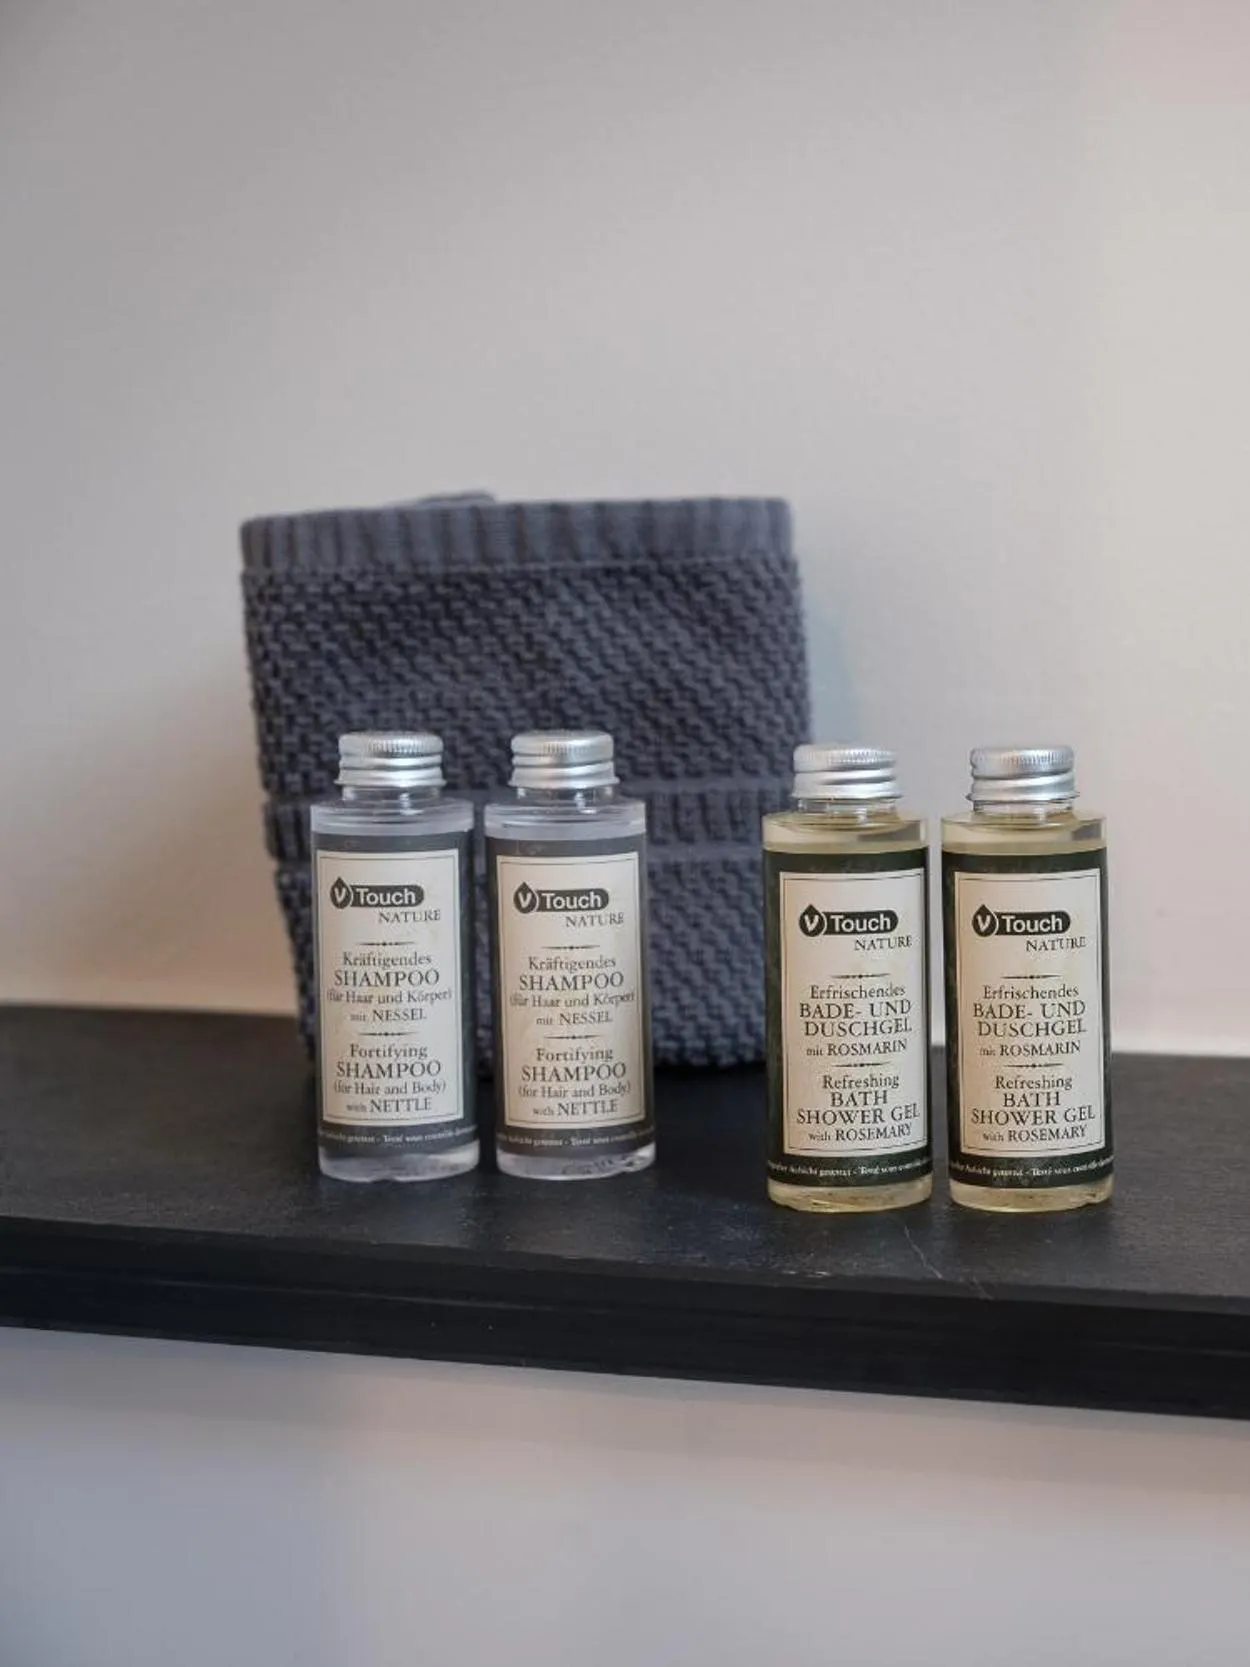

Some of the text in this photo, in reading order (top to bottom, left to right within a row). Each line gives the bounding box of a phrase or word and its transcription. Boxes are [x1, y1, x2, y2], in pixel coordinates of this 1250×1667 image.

[334, 887, 416, 905] V Touch
[518, 891, 601, 909] V Touch
[378, 909, 441, 924] NATURE
[566, 912, 624, 928] NATURE
[803, 913, 891, 933] V Touch
[976, 914, 1063, 933] V Touch
[854, 935, 912, 951] NATURE
[1026, 936, 1087, 952] NATURE
[342, 951, 432, 970] Kräftigendes
[528, 955, 617, 973] Kräftigendes
[334, 969, 440, 987] SHAMPOO
[519, 971, 624, 991] SHAMPOO
[346, 990, 373, 1004] Haar
[378, 990, 403, 1004] und
[810, 982, 906, 1000] Erfrischendes
[983, 984, 1079, 1001] Erfrischendes
[532, 995, 561, 1008] Haar
[565, 994, 589, 1007] und
[800, 999, 911, 1019] BADE- UND
[973, 1000, 1086, 1019] BADE- UND
[372, 1008, 427, 1022] NESSEL
[560, 1011, 613, 1026] NESSEL
[804, 1018, 912, 1037] DUSCHGEL
[978, 1018, 1087, 1037] DUSCHGEL
[350, 1043, 428, 1060] Fortifying
[536, 1047, 613, 1063] Fortifying
[806, 1038, 908, 1056] mit ROSMARIN
[999, 1040, 1081, 1056] ROSMARIN
[336, 1060, 441, 1079] SHAMPOO
[521, 1062, 627, 1082] SHAMPOO
[334, 1079, 447, 1095] (for Hair and Body)
[518, 1081, 631, 1099] (for Hair and Body)
[822, 1074, 900, 1090] Refreshing
[995, 1075, 1073, 1090] Refreshing
[346, 1097, 432, 1113] with NETTLE
[533, 1099, 619, 1116] with NETTLE
[831, 1090, 888, 1107] BATH
[1003, 1091, 1061, 1107] BATH
[797, 1103, 921, 1125] SHOWER GEL
[971, 1105, 1095, 1126] SHOWER GEL
[808, 1123, 913, 1142] with ROSEMARY
[983, 1124, 1087, 1142] with ROSEMARY
